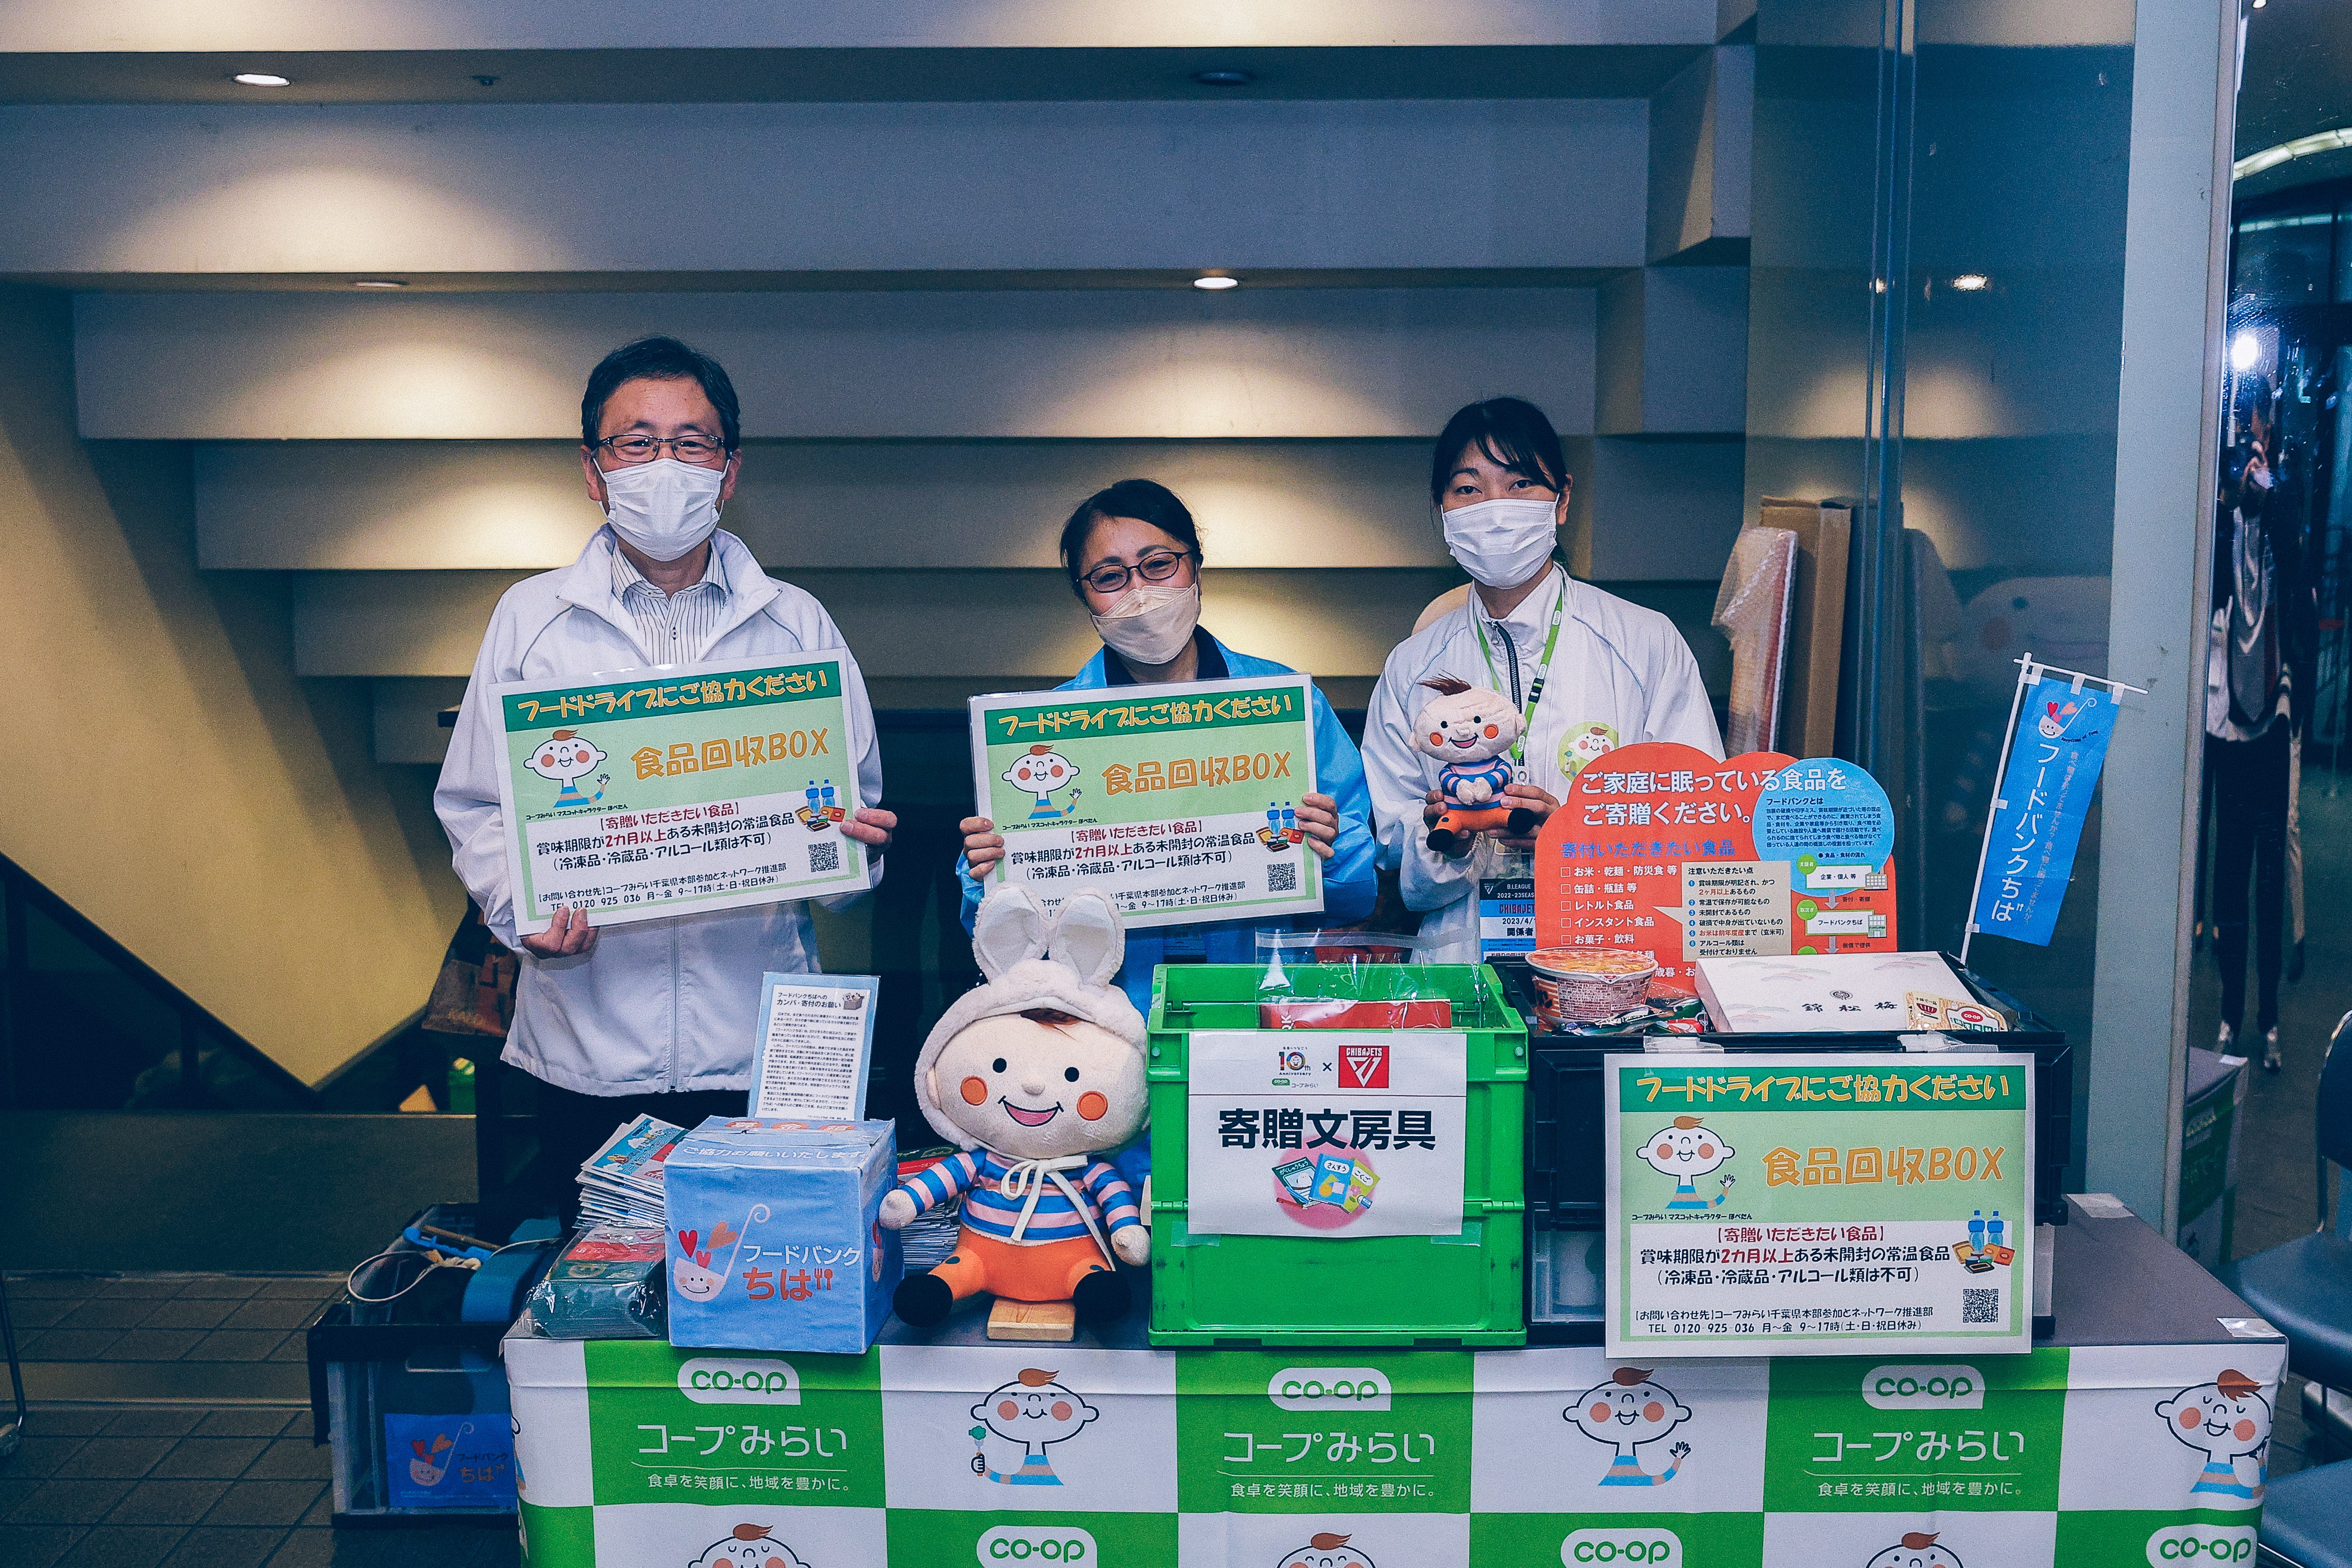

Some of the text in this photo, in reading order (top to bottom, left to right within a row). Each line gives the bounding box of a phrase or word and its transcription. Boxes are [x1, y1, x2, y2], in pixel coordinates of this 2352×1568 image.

[518, 669, 827, 721] フードドライブにご協力ください
[999, 694, 1292, 736] フードドライブにご協力ください
[630, 727, 830, 781] 食品回収BOX
[1101, 751, 1292, 796] 食品回収BOX
[1582, 766, 1847, 795] ご家庭に眠っている食品を
[1766, 797, 1824, 806] フードバンクとは
[1583, 801, 1750, 826] ご寄贈ください。
[1991, 743, 2060, 922] フードバンクちば
[1561, 839, 1735, 858] 寄付いただきたい食品
[1688, 867, 1754, 875] 注意いただきたい点
[601, 896, 618, 906] 925
[624, 894, 640, 903] 036
[1575, 900, 1634, 910] レトルト食品
[1506, 928, 1533, 936] 関係者
[1574, 916, 1654, 928] インスタント食品
[1574, 934, 1634, 945] お菓子・飲料
[1346, 1048, 1383, 1056] CHIBAJETS
[1636, 1074, 2009, 1103] フードドライブにご協力ください
[1218, 1108, 1436, 1151] 寄贈文房具
[1327, 1162, 1347, 1172] さんすう
[1354, 1170, 1371, 1183] こくご
[1762, 1145, 2005, 1188] 食品回収BOX
[743, 1245, 861, 1266] フードバンク
[743, 1267, 832, 1301] ちば
[1649, 1324, 1666, 1332] TEL
[637, 1423, 848, 1457] コープみらい
[1223, 1431, 1435, 1464] コープみらい
[1812, 1430, 2025, 1463] コープみらい
[647, 1474, 850, 1493] 食卓を笑顔に、地域を豊かに。
[1231, 1482, 1436, 1499] 食卓を笑顔に、地域を豊かに。
[1818, 1482, 2022, 1498] 食卓を笑顔に、地域を豊かに。
